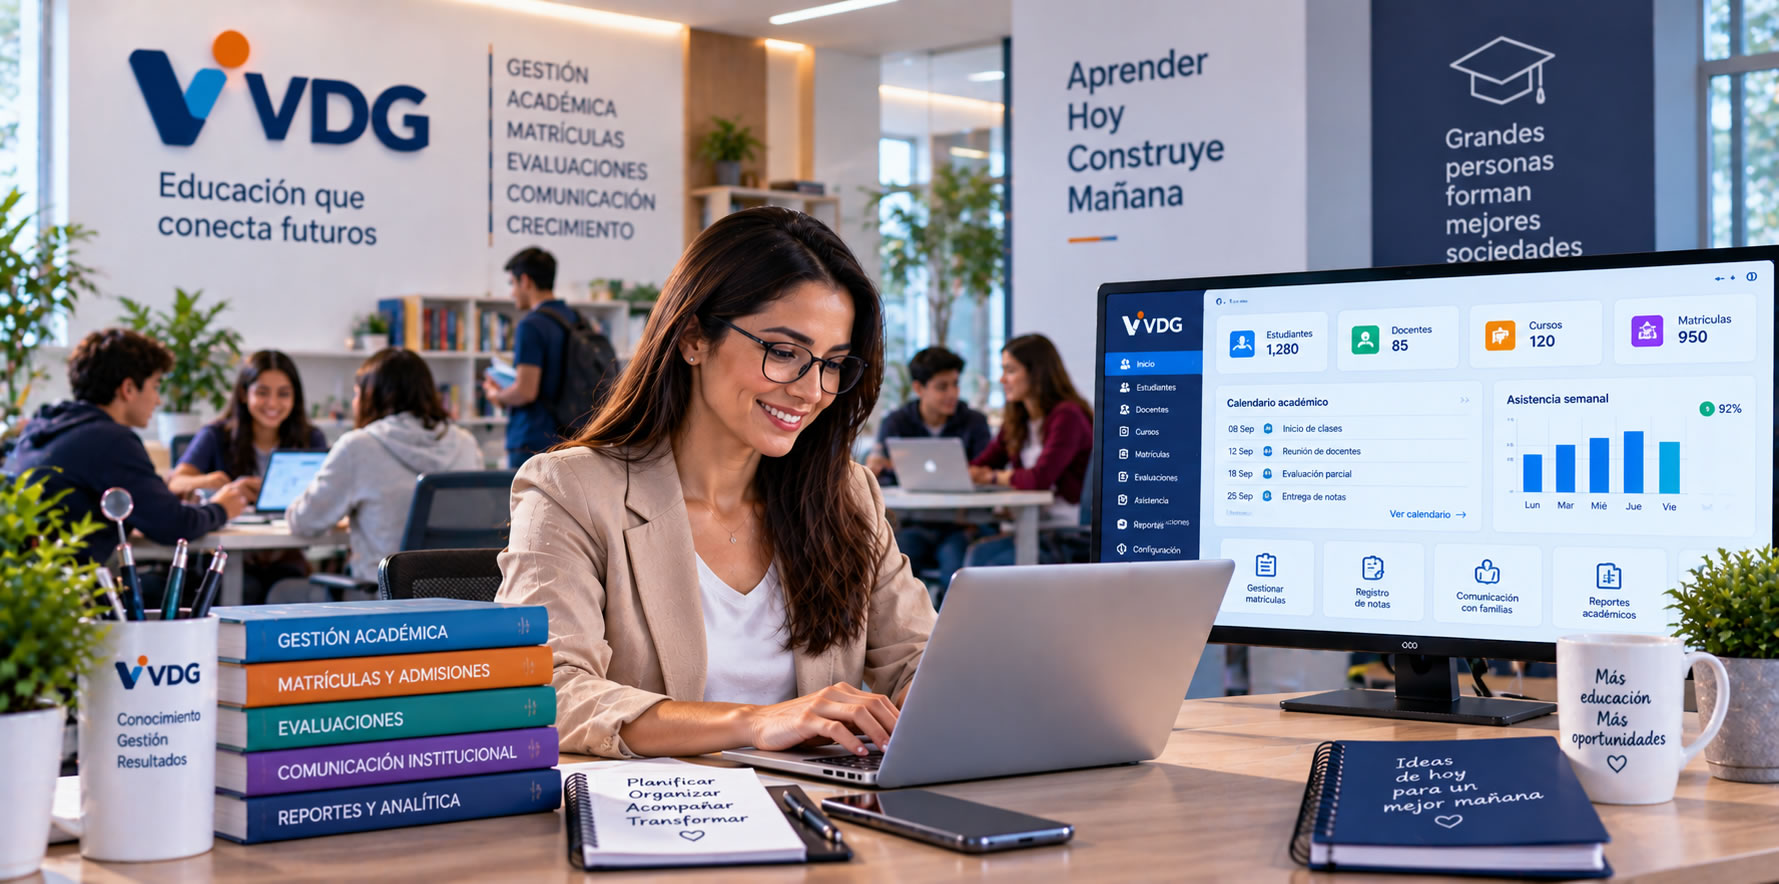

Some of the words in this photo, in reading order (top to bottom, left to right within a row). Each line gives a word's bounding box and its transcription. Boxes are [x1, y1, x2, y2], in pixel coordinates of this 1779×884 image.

[507, 58, 588, 84] GESTIÓN
[1067, 49, 1208, 93] Aprender
[507, 90, 617, 117] ACADÉMICA
[244, 72, 429, 152] VDG
[1069, 102, 1125, 134] Hoy
[507, 121, 625, 149] MATRÍCULAS
[1446, 123, 1544, 149] Grandes
[1068, 140, 1224, 172] Construye
[507, 152, 648, 181] EVALUACIONES
[1446, 155, 1554, 182] personas
[160, 172, 305, 205] Educación
[315, 189, 364, 213] que
[507, 183, 656, 211] COMUNICACIÓN
[1069, 181, 1183, 213] Mañana
[1446, 185, 1531, 206] forman
[158, 216, 271, 240] conecta
[281, 216, 377, 245] futuros
[507, 215, 634, 240] CRECIMIENTO
[1447, 212, 1540, 238] mejores
[1447, 235, 1583, 263] sociedades
[1142, 316, 1182, 335] VDG
[1392, 326, 1432, 335] Docentes
[1528, 320, 1562, 331] Cursos
[1266, 330, 1314, 340] Estudiantes
[1530, 334, 1556, 348] 120
[1678, 330, 1708, 344] 950
[1266, 342, 1298, 358] 1,280
[1392, 340, 1408, 352] 85
[1136, 384, 1176, 392] Estudiantes
[1226, 398, 1276, 408] Calendario
[1278, 396, 1328, 408] académico
[1506, 394, 1560, 405] Asistencia
[1564, 392, 1608, 404] semanal
[1718, 404, 1742, 414] 92%
[1228, 424, 1238, 433] 08
[1240, 424, 1254, 435] Sep
[1282, 424, 1304, 433] Inicio
[1306, 424, 1316, 433] de
[1318, 424, 1342, 433] clases
[1228, 448, 1238, 456] 12
[1238, 448, 1254, 457] Sep
[1282, 446, 1312, 456] Reunión
[1314, 448, 1324, 456] de
[1326, 448, 1362, 456] docentes
[1228, 470, 1236, 478] 18
[1238, 470, 1254, 480] Sep
[1282, 470, 1324, 478] Evaluación
[1326, 470, 1352, 480] parcial
[1238, 492, 1254, 502] Sep
[1282, 492, 1312, 503] Entrega
[1312, 492, 1324, 501] de
[1324, 494, 1346, 502] notas
[1524, 500, 1540, 510] Lun
[1558, 502, 1574, 510] Mar
[1590, 500, 1608, 511] Mié
[1626, 502, 1642, 511] Jue
[1662, 502, 1676, 512] Vie
[1390, 510, 1406, 519] Ver
[1406, 510, 1452, 520] calendario
[1246, 584, 1284, 594] Gestionar
[1356, 588, 1390, 600] Registro
[1354, 598, 1366, 608] de
[1368, 600, 1390, 609] notas
[1456, 592, 1520, 603] Comunicación
[1588, 596, 1630, 609] Reportes
[1460, 604, 1478, 613] con
[1480, 604, 1512, 615] familias
[1582, 610, 1636, 620] académicos
[278, 628, 349, 648] GESTIÓN
[355, 624, 448, 643] ACADÉMICA
[147, 663, 200, 686] VDG
[279, 670, 380, 692] MATRÍCULAS
[385, 670, 395, 684] Y
[399, 664, 490, 683] ADMISIONES
[1596, 668, 1626, 685] Más
[1581, 690, 1651, 704] educación
[117, 710, 200, 726] Conocimiento
[279, 712, 404, 737] EVALUACIONES
[1597, 711, 1628, 727] Más
[117, 732, 168, 747] Gestión
[1572, 730, 1665, 749] oportunidades
[117, 753, 187, 768] Resultados
[278, 755, 404, 781] COMUNICACIÓN
[409, 746, 517, 769] INSTITUCIONAL
[1396, 757, 1453, 769] Ideas
[628, 777, 715, 787] Planificar
[1396, 771, 1420, 782] de
[1430, 769, 1466, 781] hoy
[629, 789, 720, 801] Organizar
[1393, 787, 1441, 799] para
[1450, 784, 1477, 792] un
[279, 803, 362, 825] REPORTES
[366, 801, 376, 816] Y
[380, 792, 460, 815] ANALÍTICA
[626, 802, 733, 813] Acompañar
[1384, 800, 1444, 815] mejor
[1455, 791, 1544, 807] mañana
[626, 815, 748, 826] Transformar
